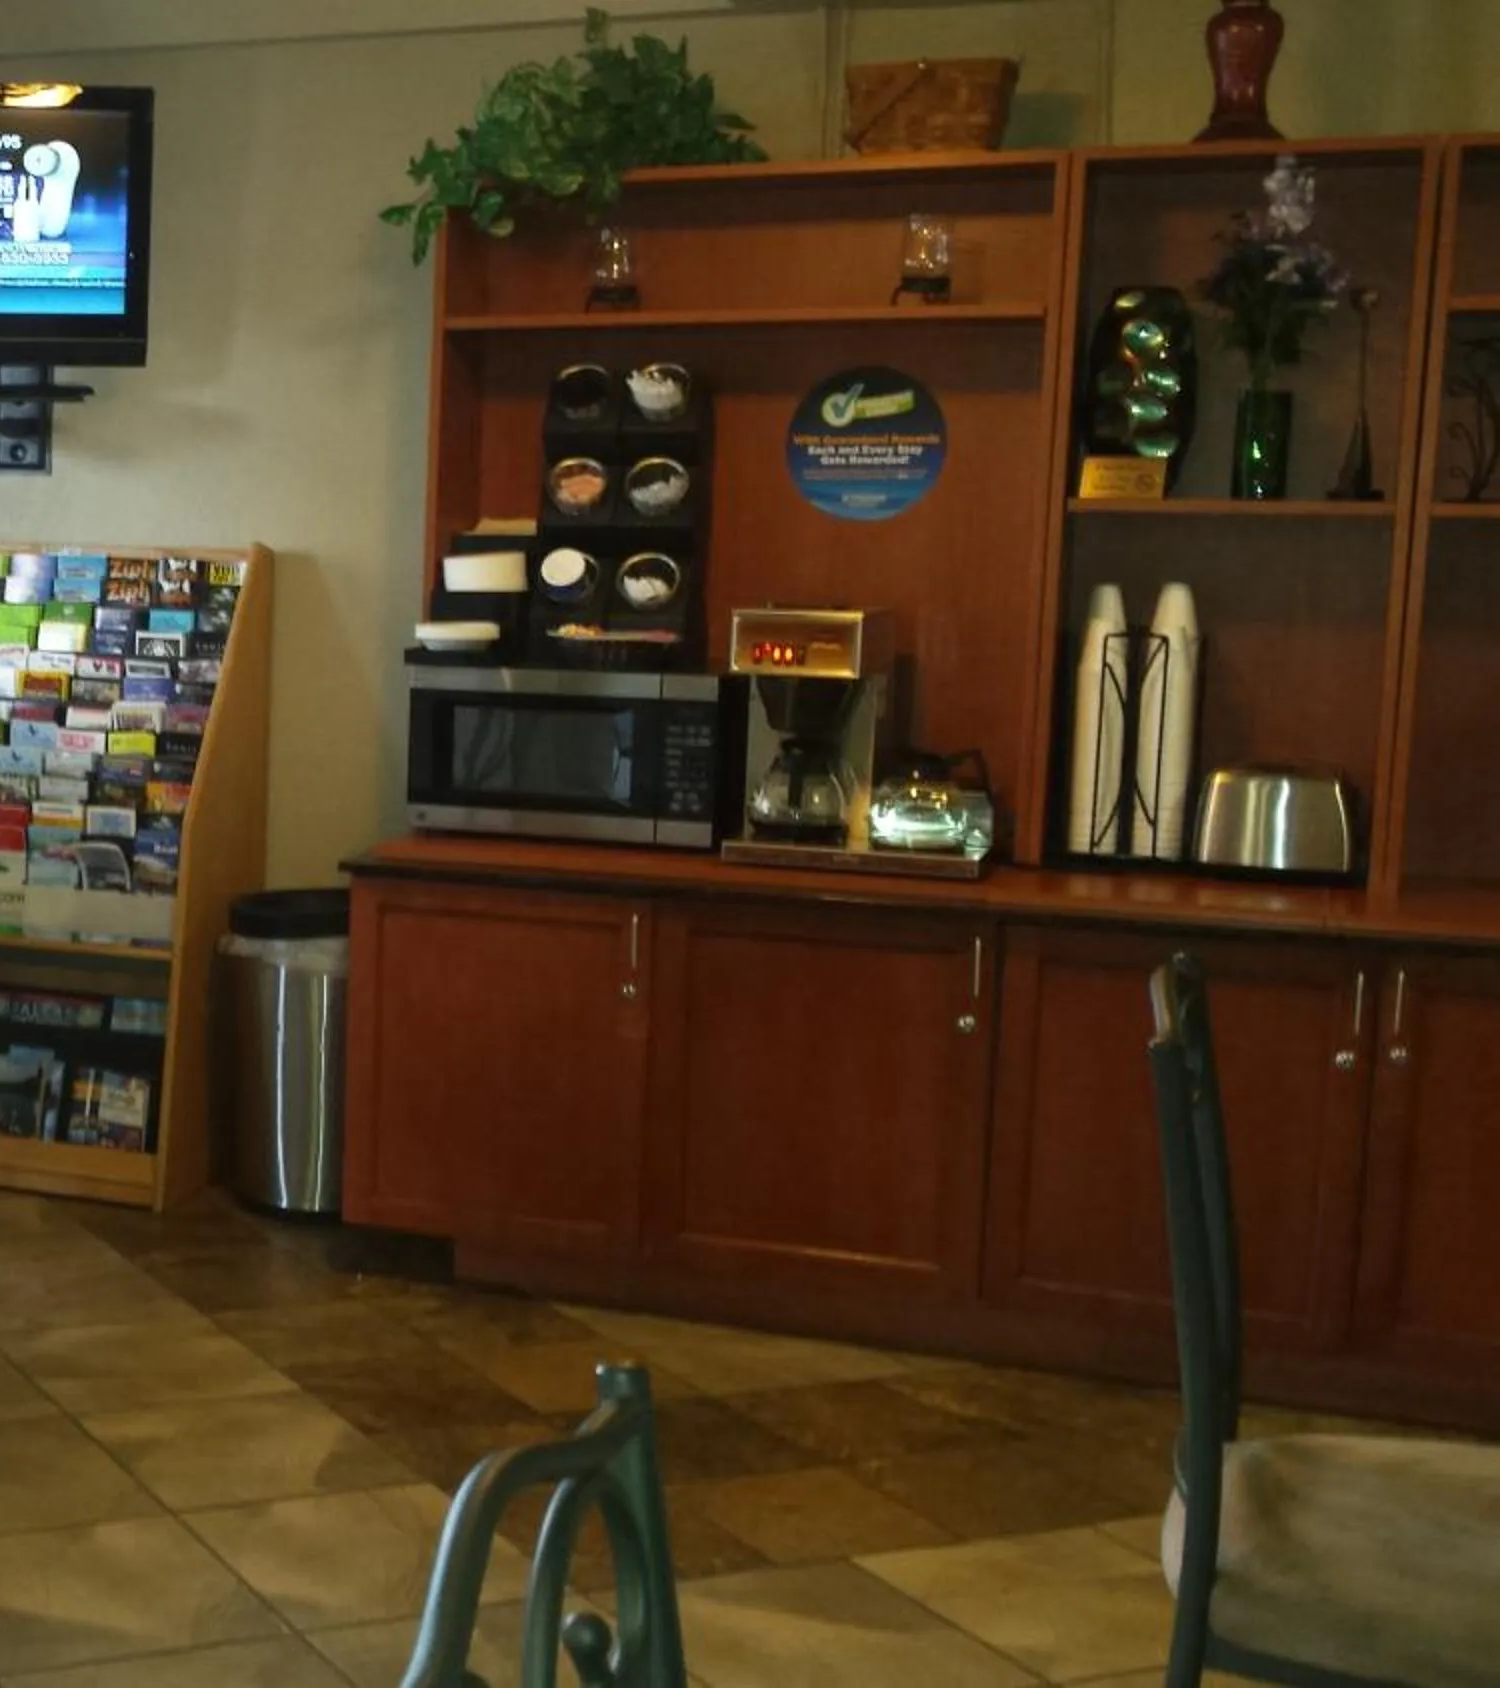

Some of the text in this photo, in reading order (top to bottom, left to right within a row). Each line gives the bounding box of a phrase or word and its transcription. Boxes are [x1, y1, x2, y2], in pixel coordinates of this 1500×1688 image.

[808, 445, 923, 457] Each and Every Stay
[820, 456, 846, 465] Gets
